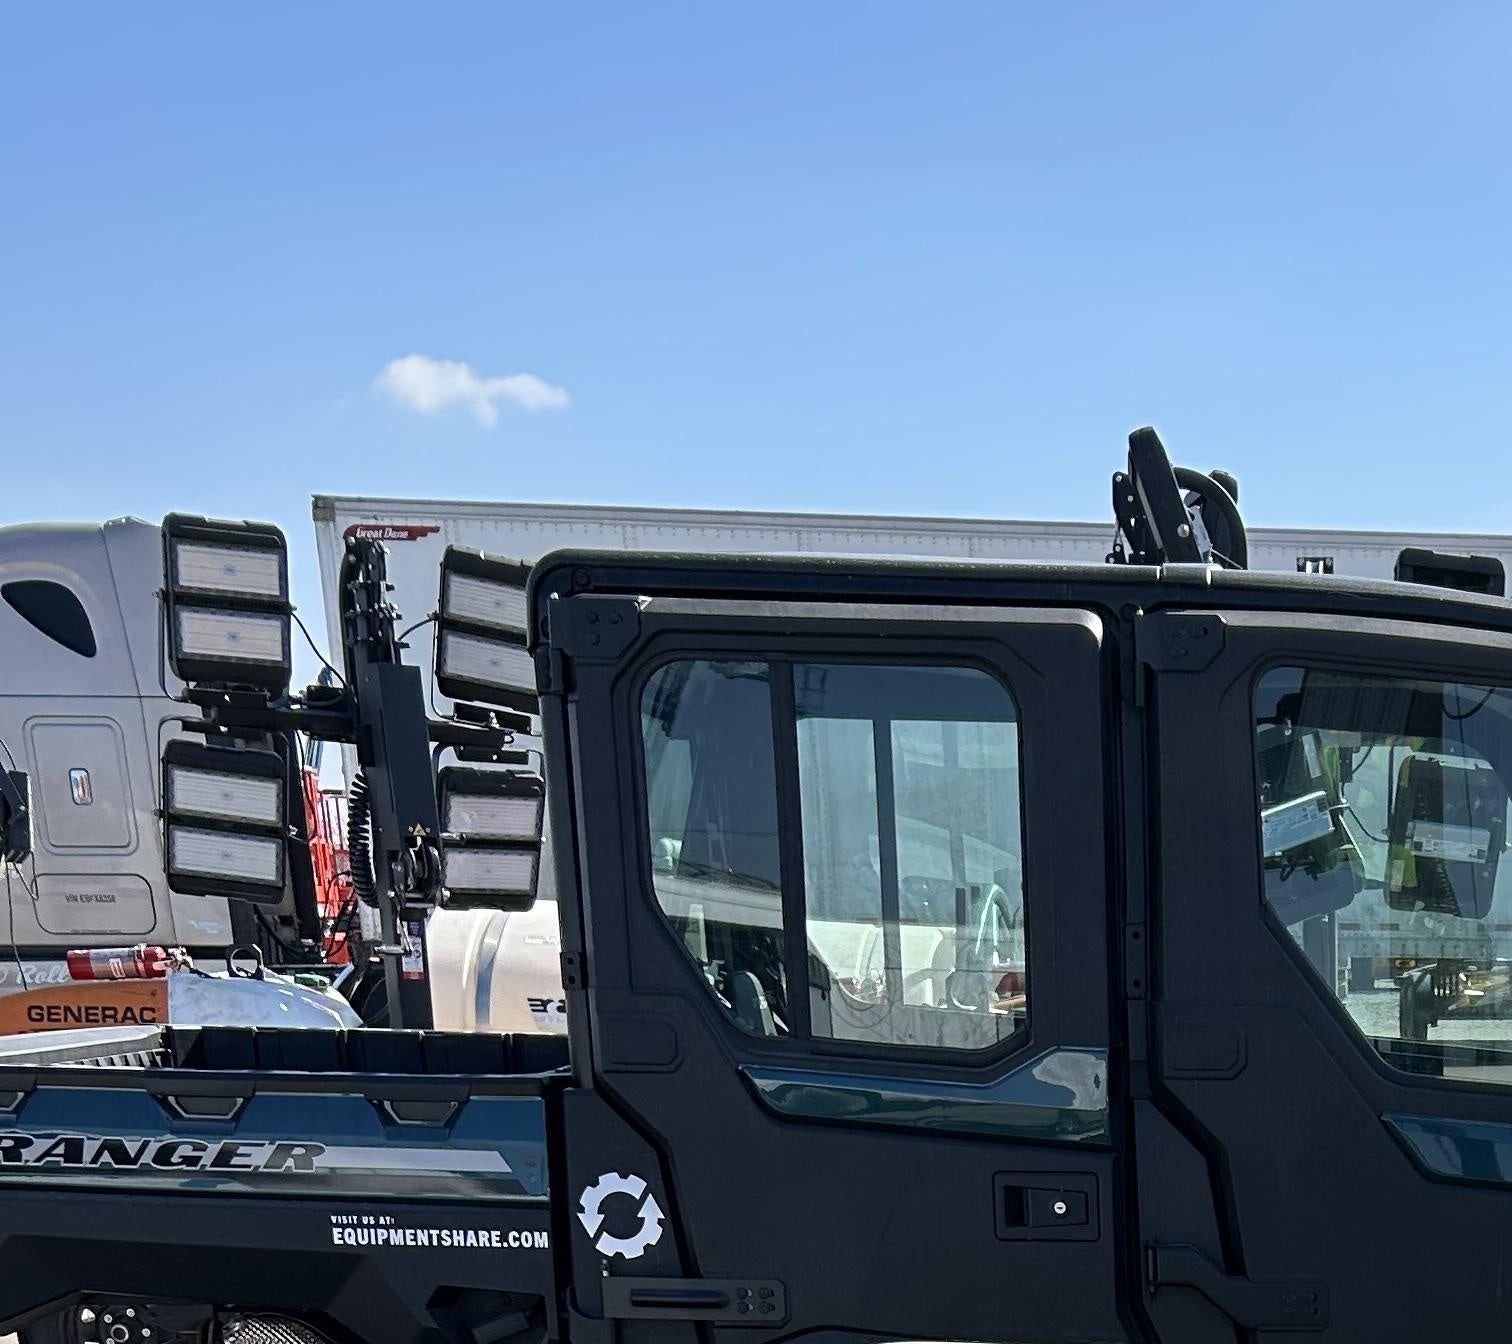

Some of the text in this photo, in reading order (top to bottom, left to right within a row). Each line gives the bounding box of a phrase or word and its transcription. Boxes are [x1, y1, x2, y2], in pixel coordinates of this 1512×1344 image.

[355, 527, 382, 539] Great
[27, 1005, 157, 1024] GENERAC
[0, 1134, 326, 1173] RANGER
[331, 1215, 358, 1225] VISIT
[362, 1216, 376, 1225] US
[332, 1227, 549, 1249] EQUIPMENTSHARE.COM
